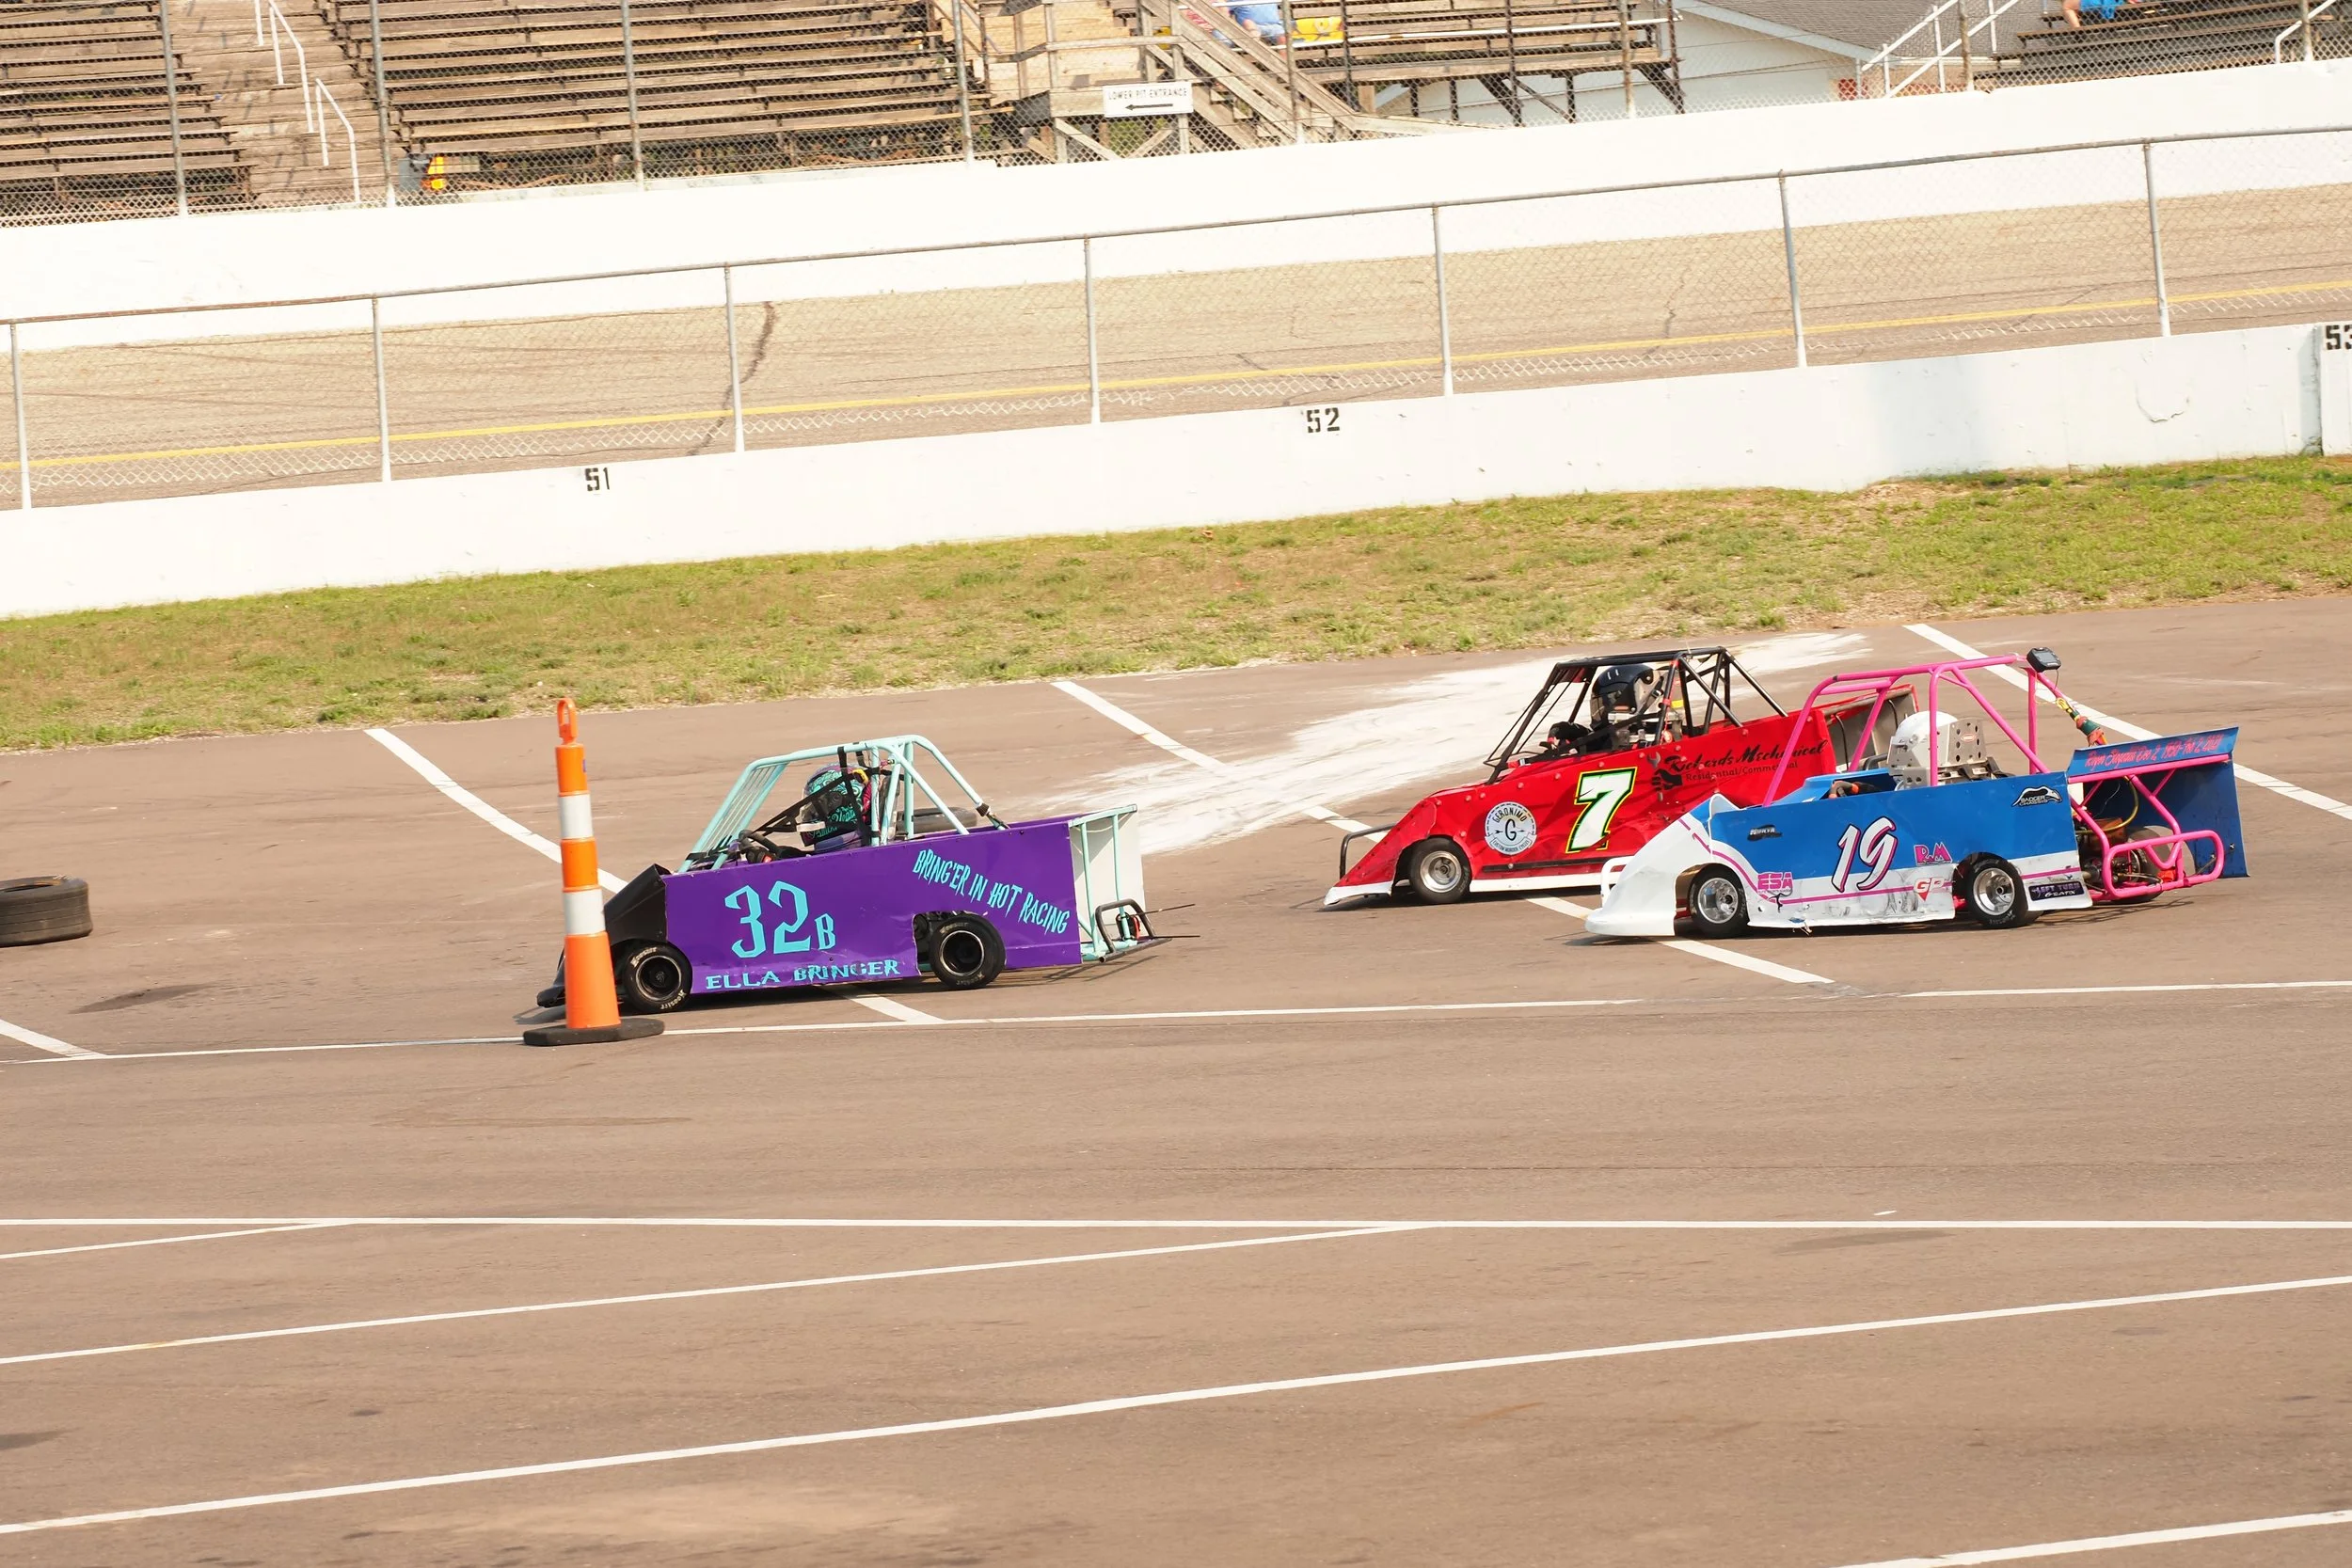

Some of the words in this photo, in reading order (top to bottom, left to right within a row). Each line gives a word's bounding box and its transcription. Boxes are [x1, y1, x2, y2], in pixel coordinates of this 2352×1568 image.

[1107, 90, 1133, 101] LOWER
[1136, 88, 1147, 98] PIT
[1149, 87, 1187, 99] ENTRANCE
[1306, 407, 1340, 434] 52
[584, 467, 610, 491] 51
[1736, 739, 1829, 764] Mechnical
[1491, 807, 1528, 824] GERONIMO
[1565, 767, 1638, 853] 7
[1504, 817, 1518, 842] G
[1831, 816, 1899, 894] 19
[1757, 872, 1793, 890] ESA
[968, 873, 989, 903] IN
[987, 882, 1024, 918] HOT
[1017, 892, 1071, 935] RACING
[706, 970, 781, 990] ELLA
[793, 958, 901, 982] BRINGER
